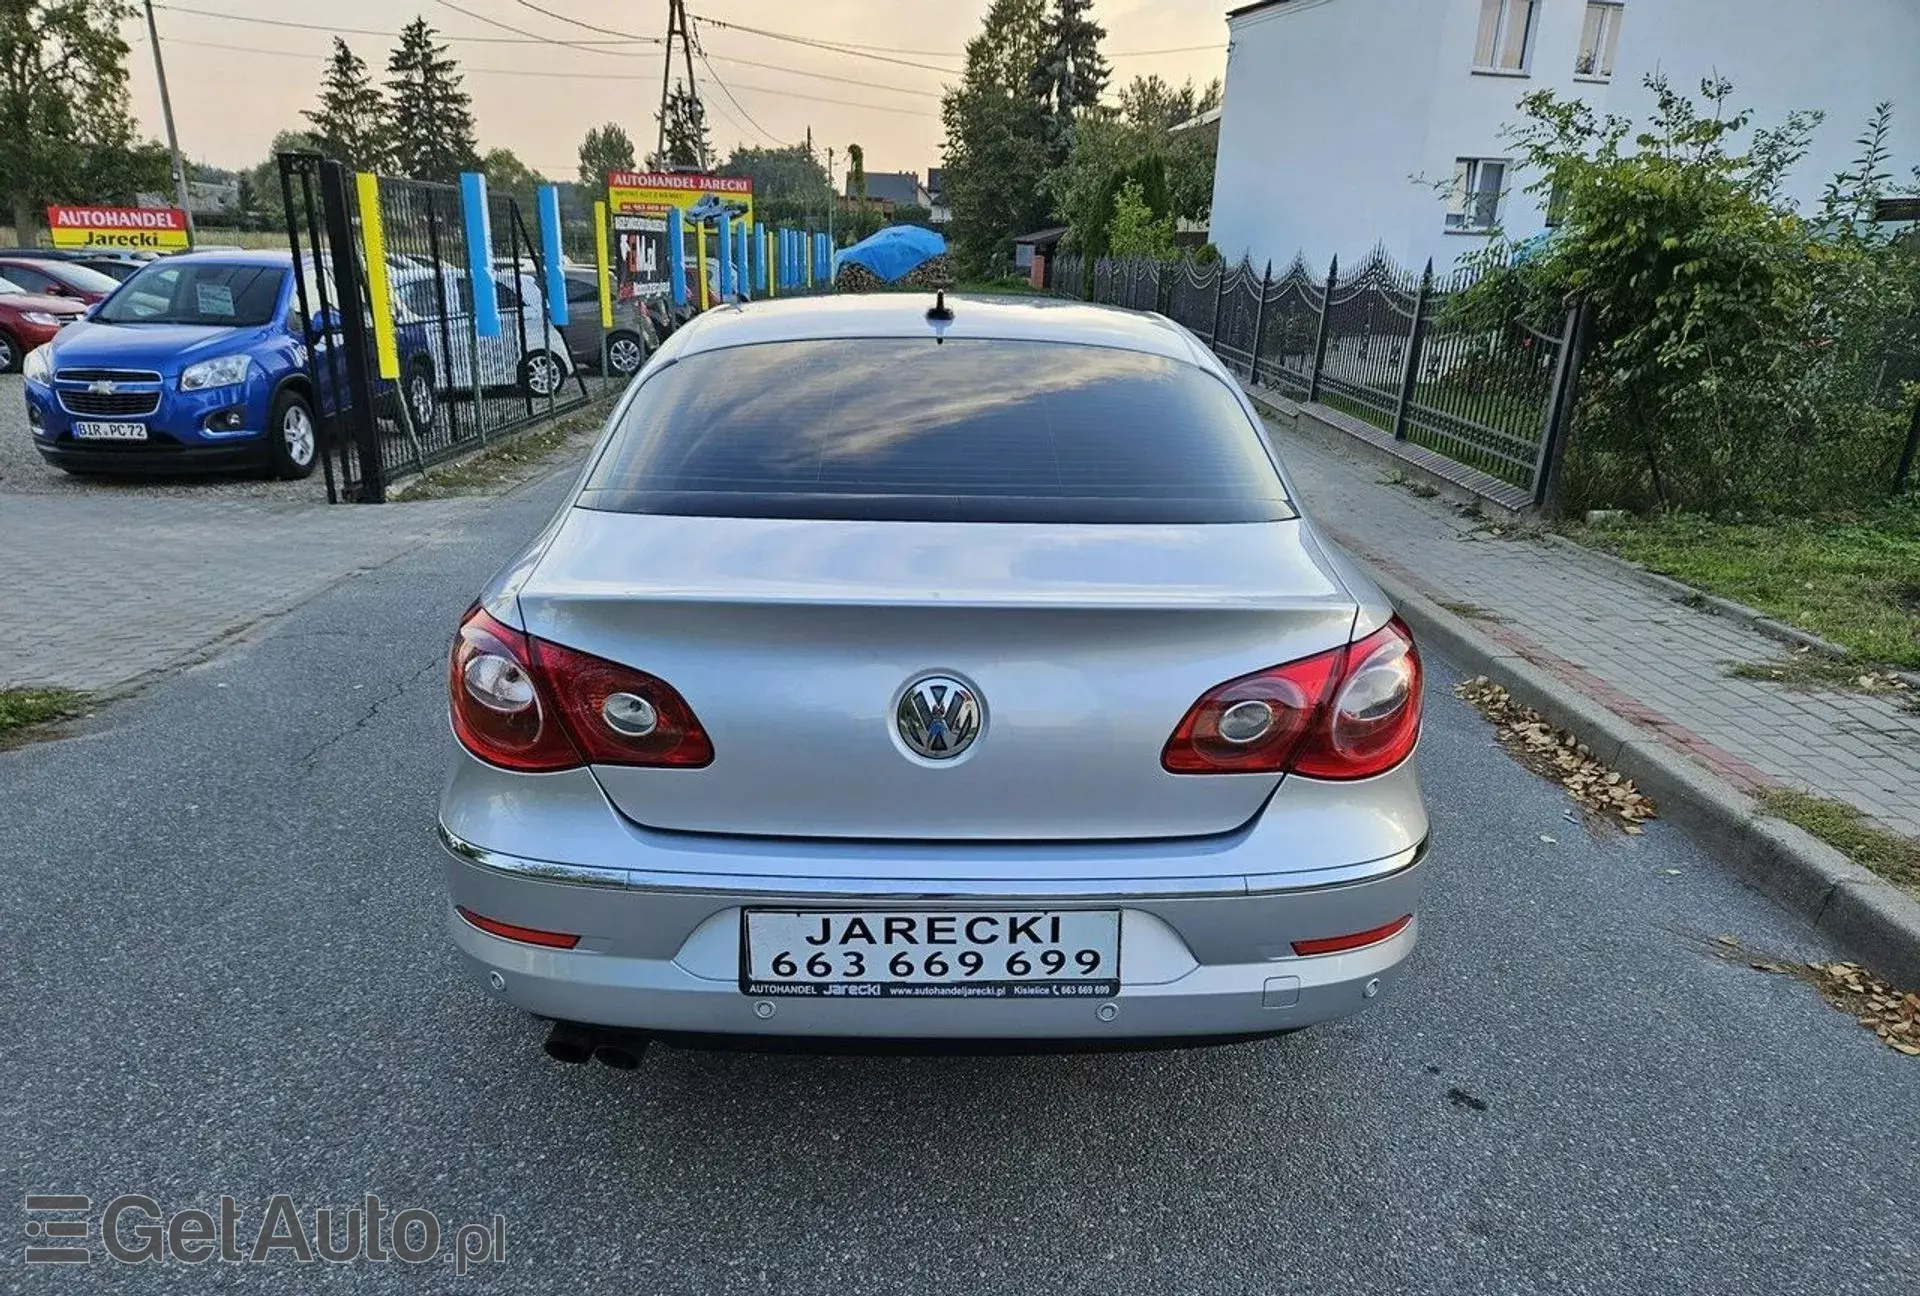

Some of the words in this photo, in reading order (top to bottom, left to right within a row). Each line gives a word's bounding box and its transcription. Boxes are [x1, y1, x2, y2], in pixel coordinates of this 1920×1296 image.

[614, 175, 697, 188] AUTOHANDEL
[700, 178, 748, 191] JARECKI
[58, 210, 177, 228] AUTOHANDEL
[84, 231, 159, 247] Jarecki
[805, 916, 1061, 946] JARECKI
[771, 950, 867, 978] 663
[888, 950, 984, 978] 669
[1005, 948, 1102, 977] 699
[750, 984, 818, 995] AUTOHANDEL
[823, 984, 881, 996] Jarecki
[889, 985, 1007, 998] www.autohandeljarecki.pl
[1013, 985, 1050, 995] Kisielice
[1061, 985, 1077, 995] 663
[1077, 985, 1094, 995] 669
[1094, 985, 1110, 995] 699
